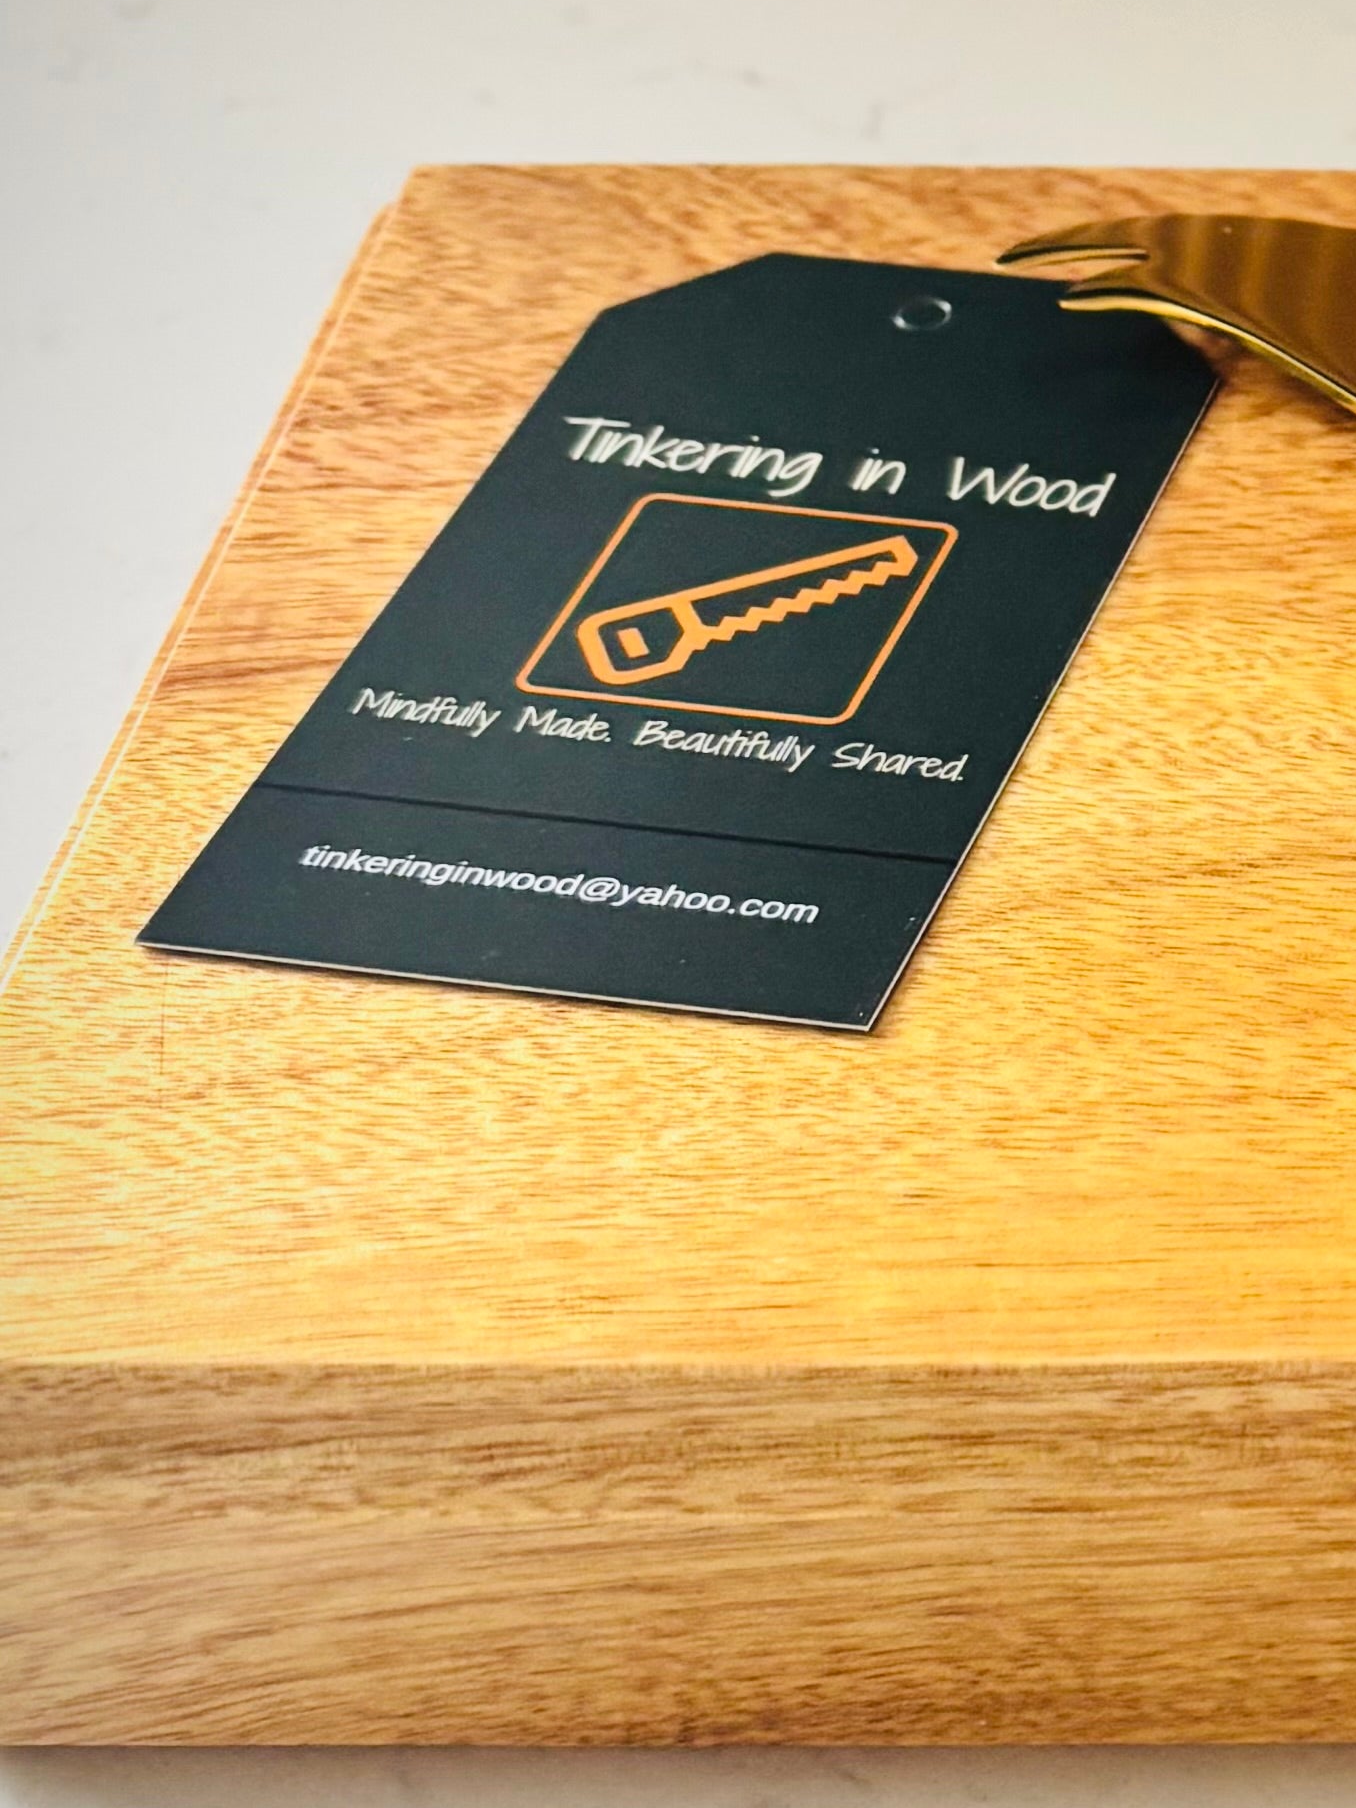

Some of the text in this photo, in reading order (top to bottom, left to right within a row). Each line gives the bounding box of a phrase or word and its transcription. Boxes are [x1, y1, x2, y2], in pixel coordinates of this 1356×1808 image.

[562, 416, 1117, 518] Tinkering in Wood
[352, 687, 966, 783] Mindfully Made. Beautifully Shared.
[299, 845, 820, 924] tinkeringinwood@yahoo.com
